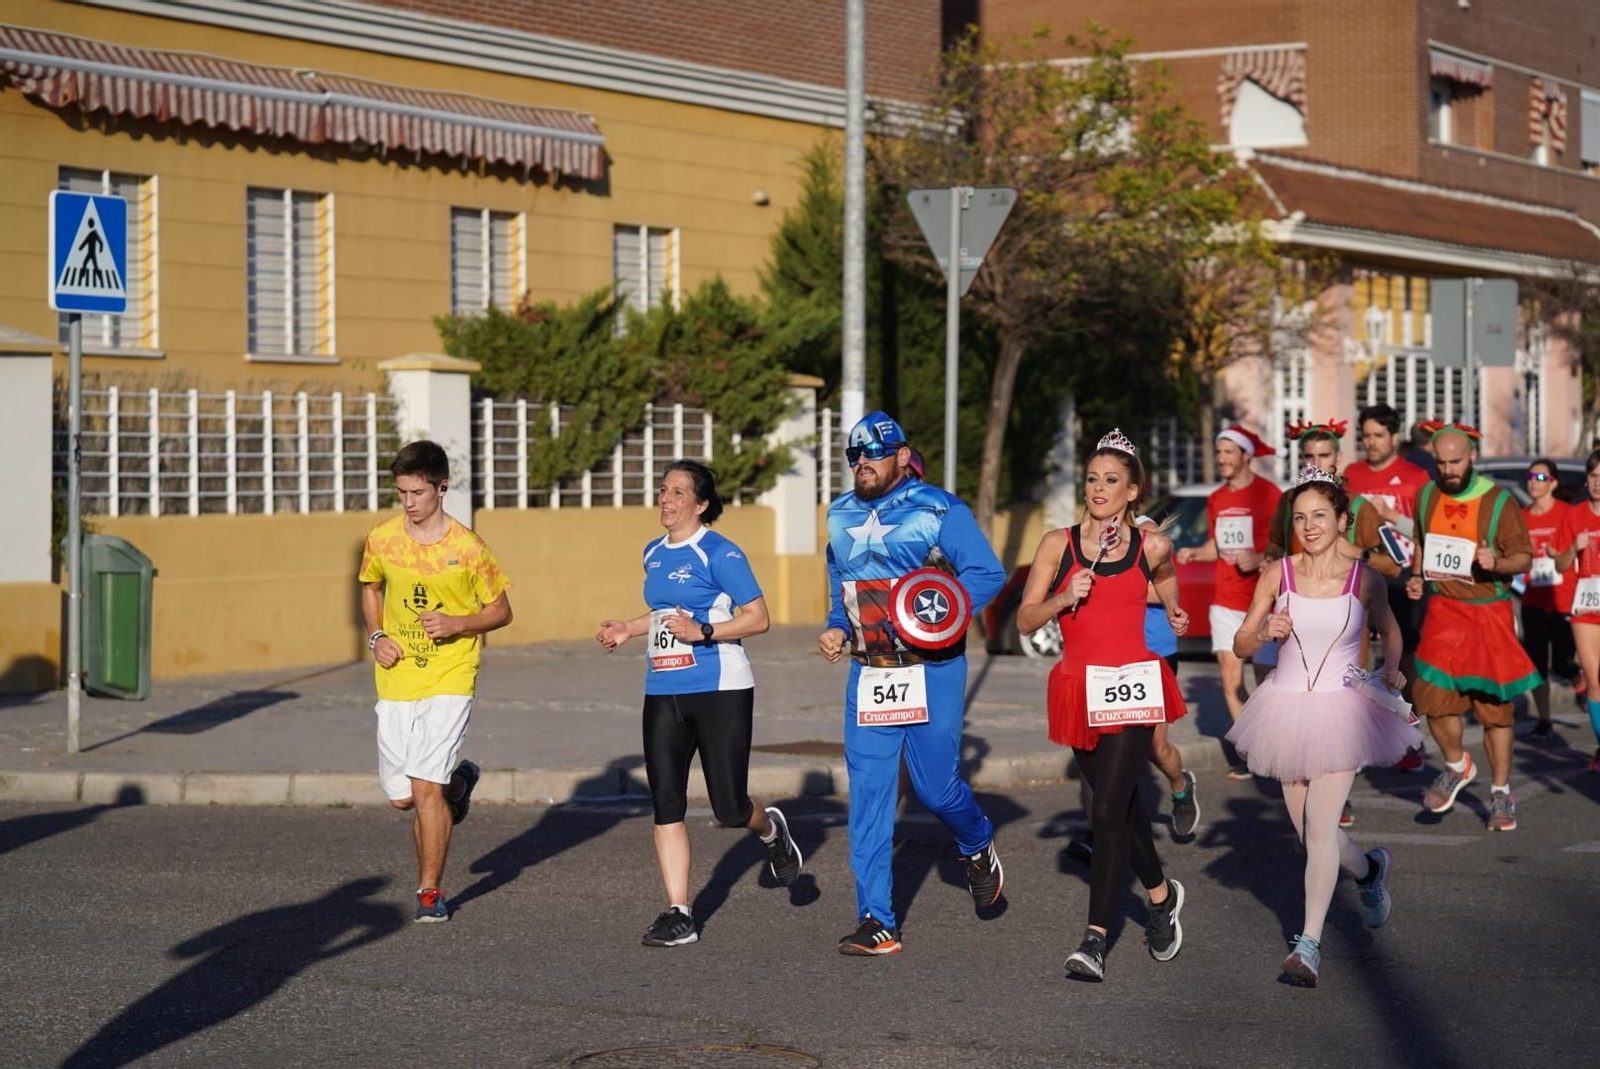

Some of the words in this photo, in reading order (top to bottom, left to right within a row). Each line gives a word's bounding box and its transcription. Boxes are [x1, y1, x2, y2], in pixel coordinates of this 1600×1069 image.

[1223, 531, 1244, 544] 210
[1435, 552, 1461, 570] 109
[399, 629, 425, 639] WITH
[654, 631, 676, 649] 467
[873, 683, 910, 704] 547
[1104, 683, 1146, 703] 593
[864, 710, 914, 722] Cruzcampo
[1095, 708, 1150, 722] Cruzcampo
